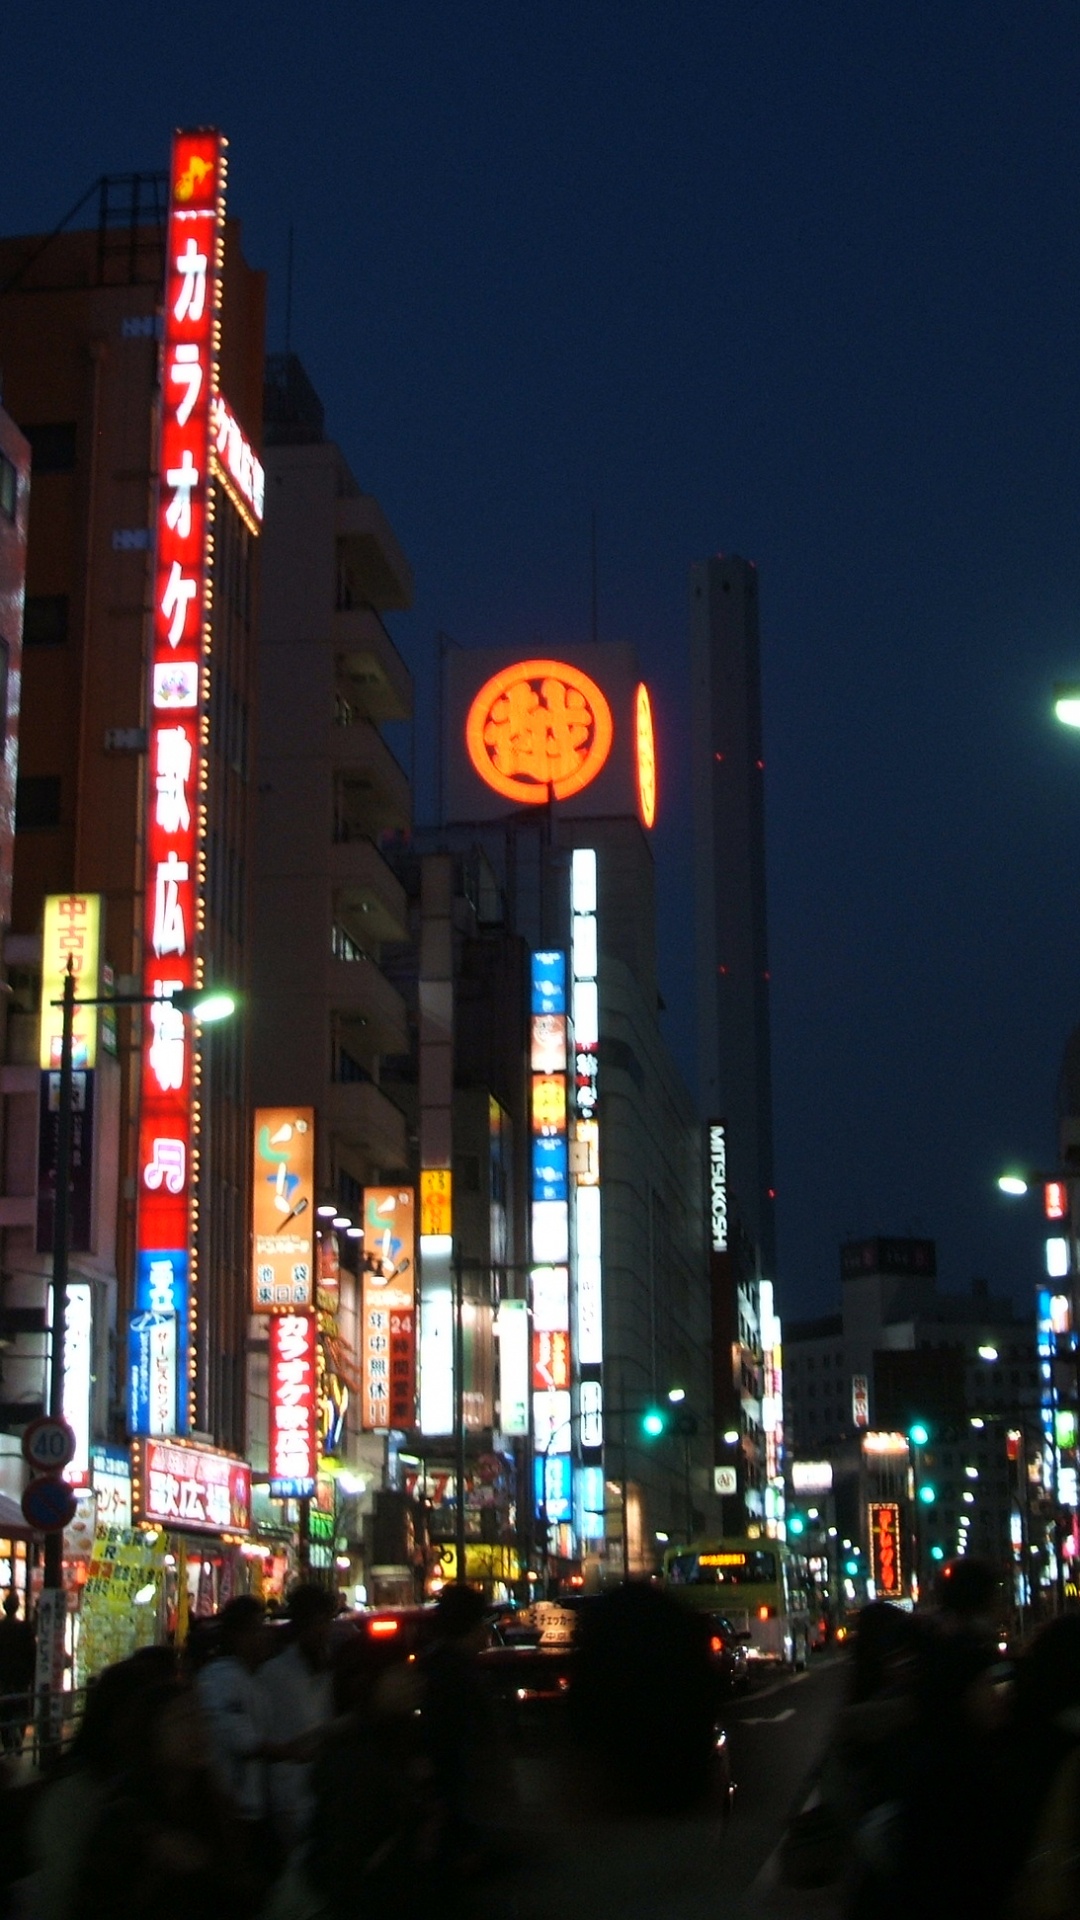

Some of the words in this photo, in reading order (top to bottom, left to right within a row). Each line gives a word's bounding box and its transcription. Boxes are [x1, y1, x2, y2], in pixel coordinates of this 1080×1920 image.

[160, 238, 207, 647] カラオケ
[710, 1126, 727, 1252] MITSUKOSHI
[33, 1431, 64, 1457] 40
[150, 1470, 231, 1526] 歌広場
[540, 1613, 572, 1626] チェッカー
